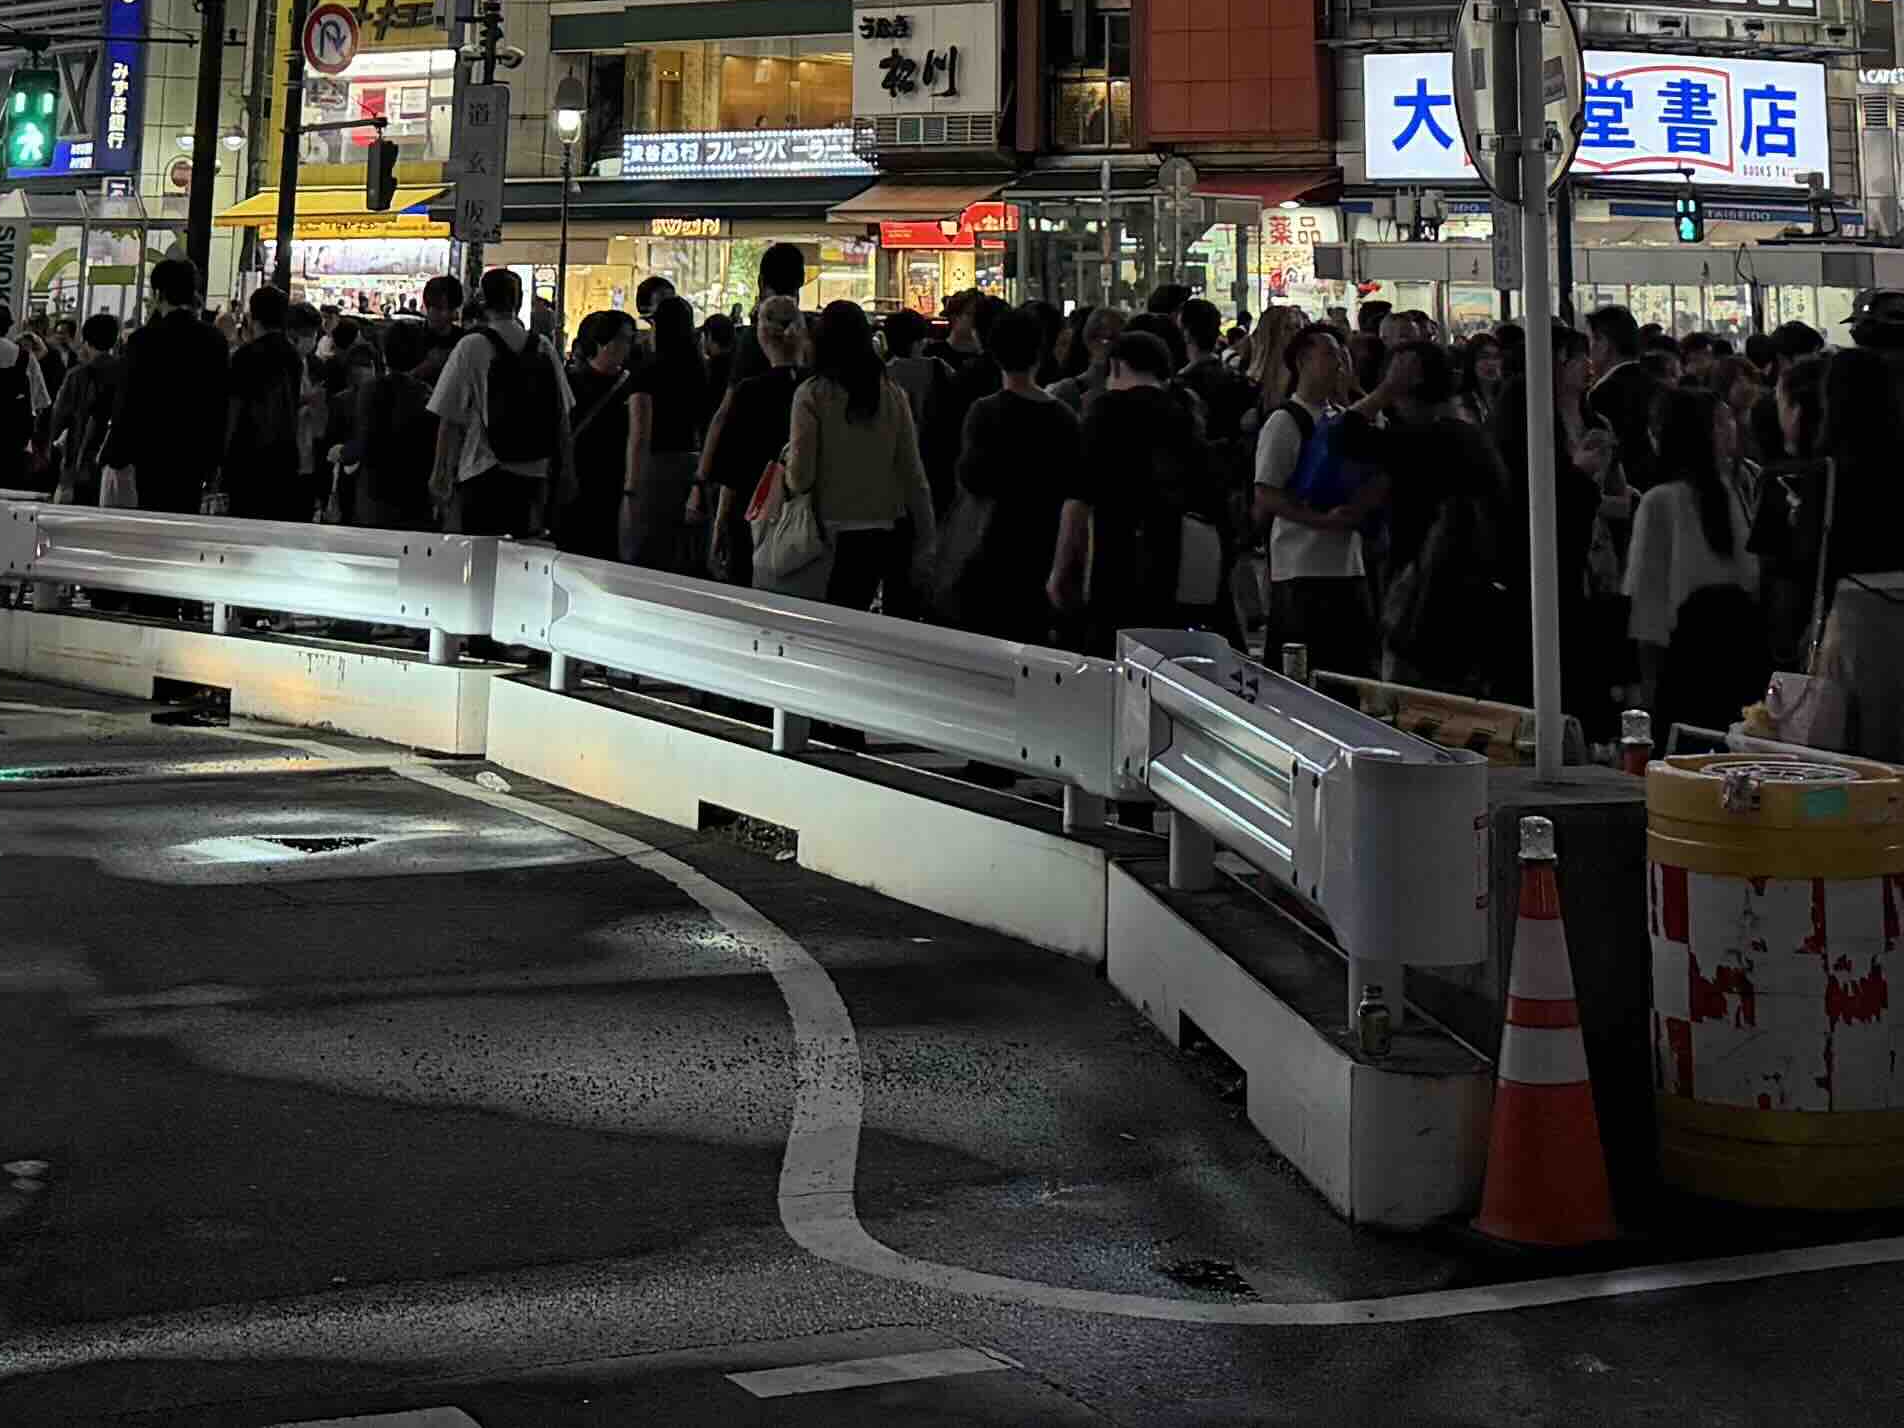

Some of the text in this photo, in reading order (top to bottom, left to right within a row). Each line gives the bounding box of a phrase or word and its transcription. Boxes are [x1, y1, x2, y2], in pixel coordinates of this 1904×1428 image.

[108, 62, 130, 150] みずほ銀行
[1391, 76, 1799, 158] 大堂書店
[626, 142, 699, 164] 渋谷西村
